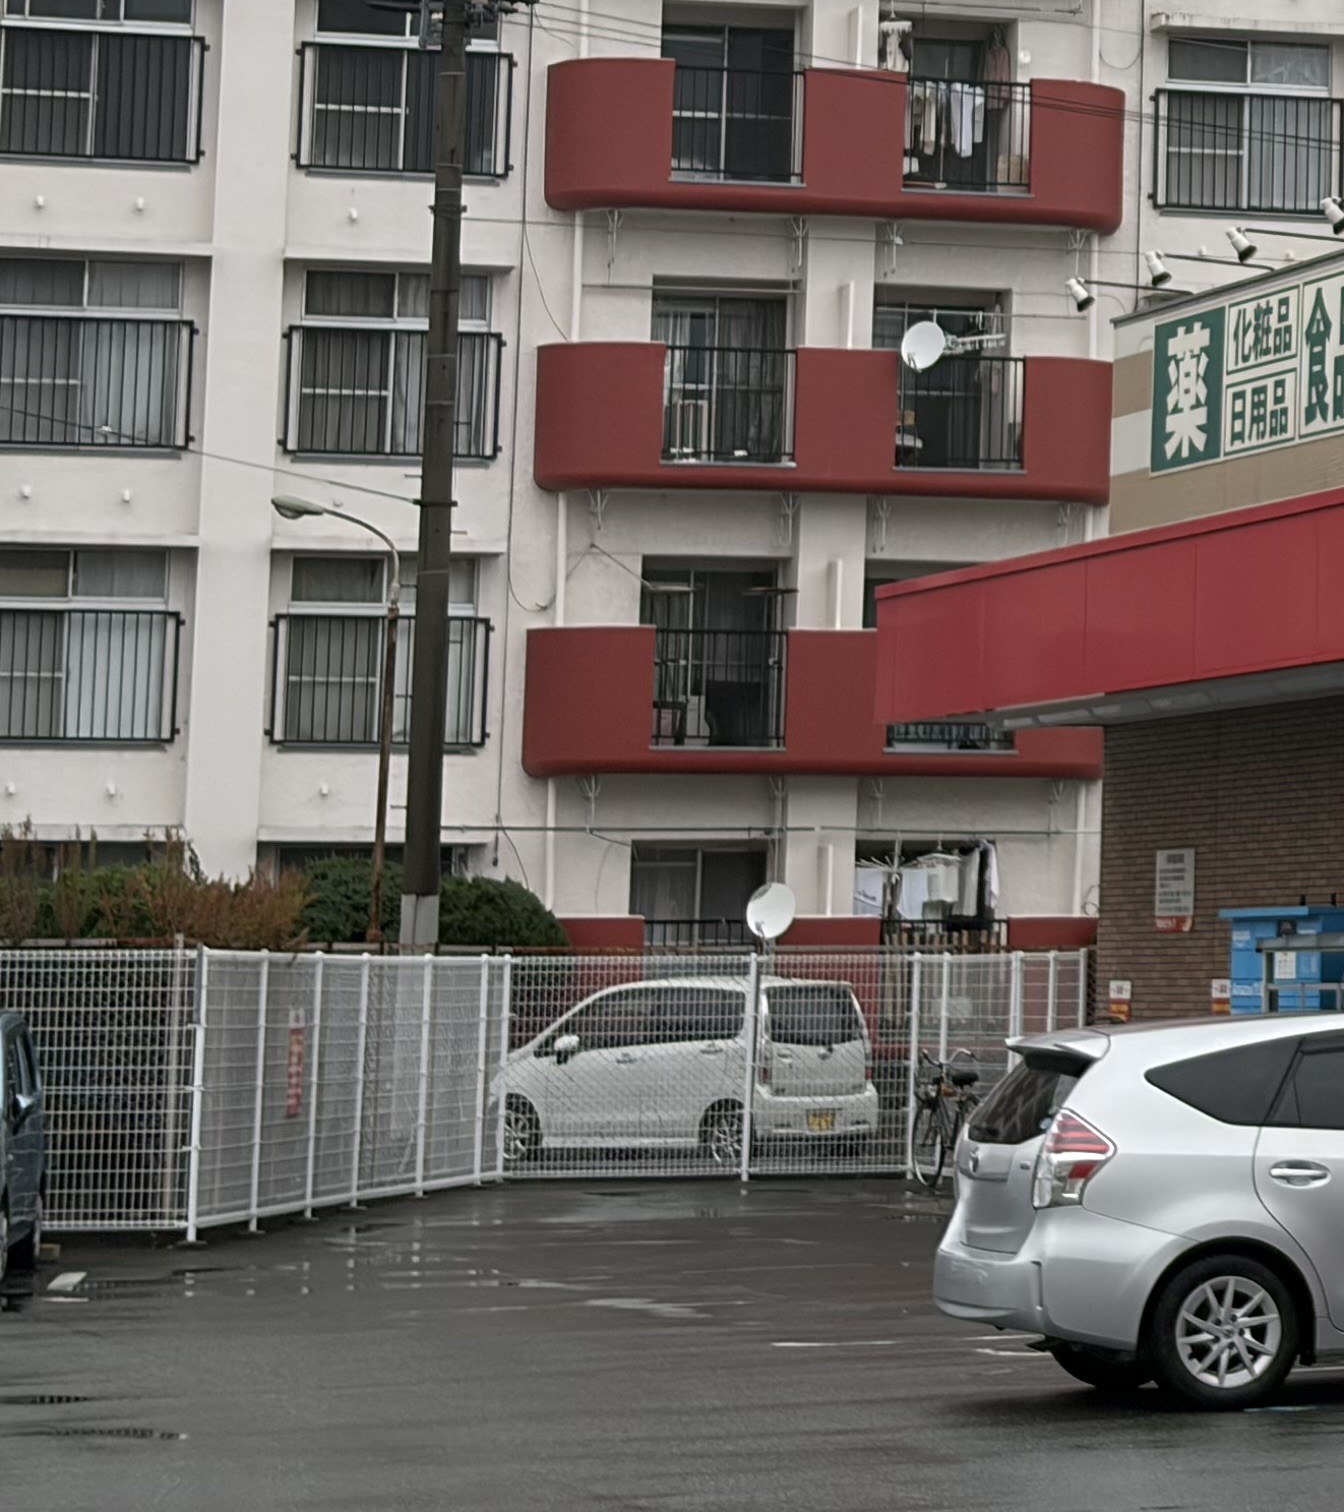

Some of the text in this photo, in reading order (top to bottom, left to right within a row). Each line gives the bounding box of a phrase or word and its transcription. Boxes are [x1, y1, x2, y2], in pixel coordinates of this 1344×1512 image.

[1232, 295, 1293, 368] 化粧品
[1165, 320, 1211, 461] 薬
[1230, 377, 1289, 447] 日用品
